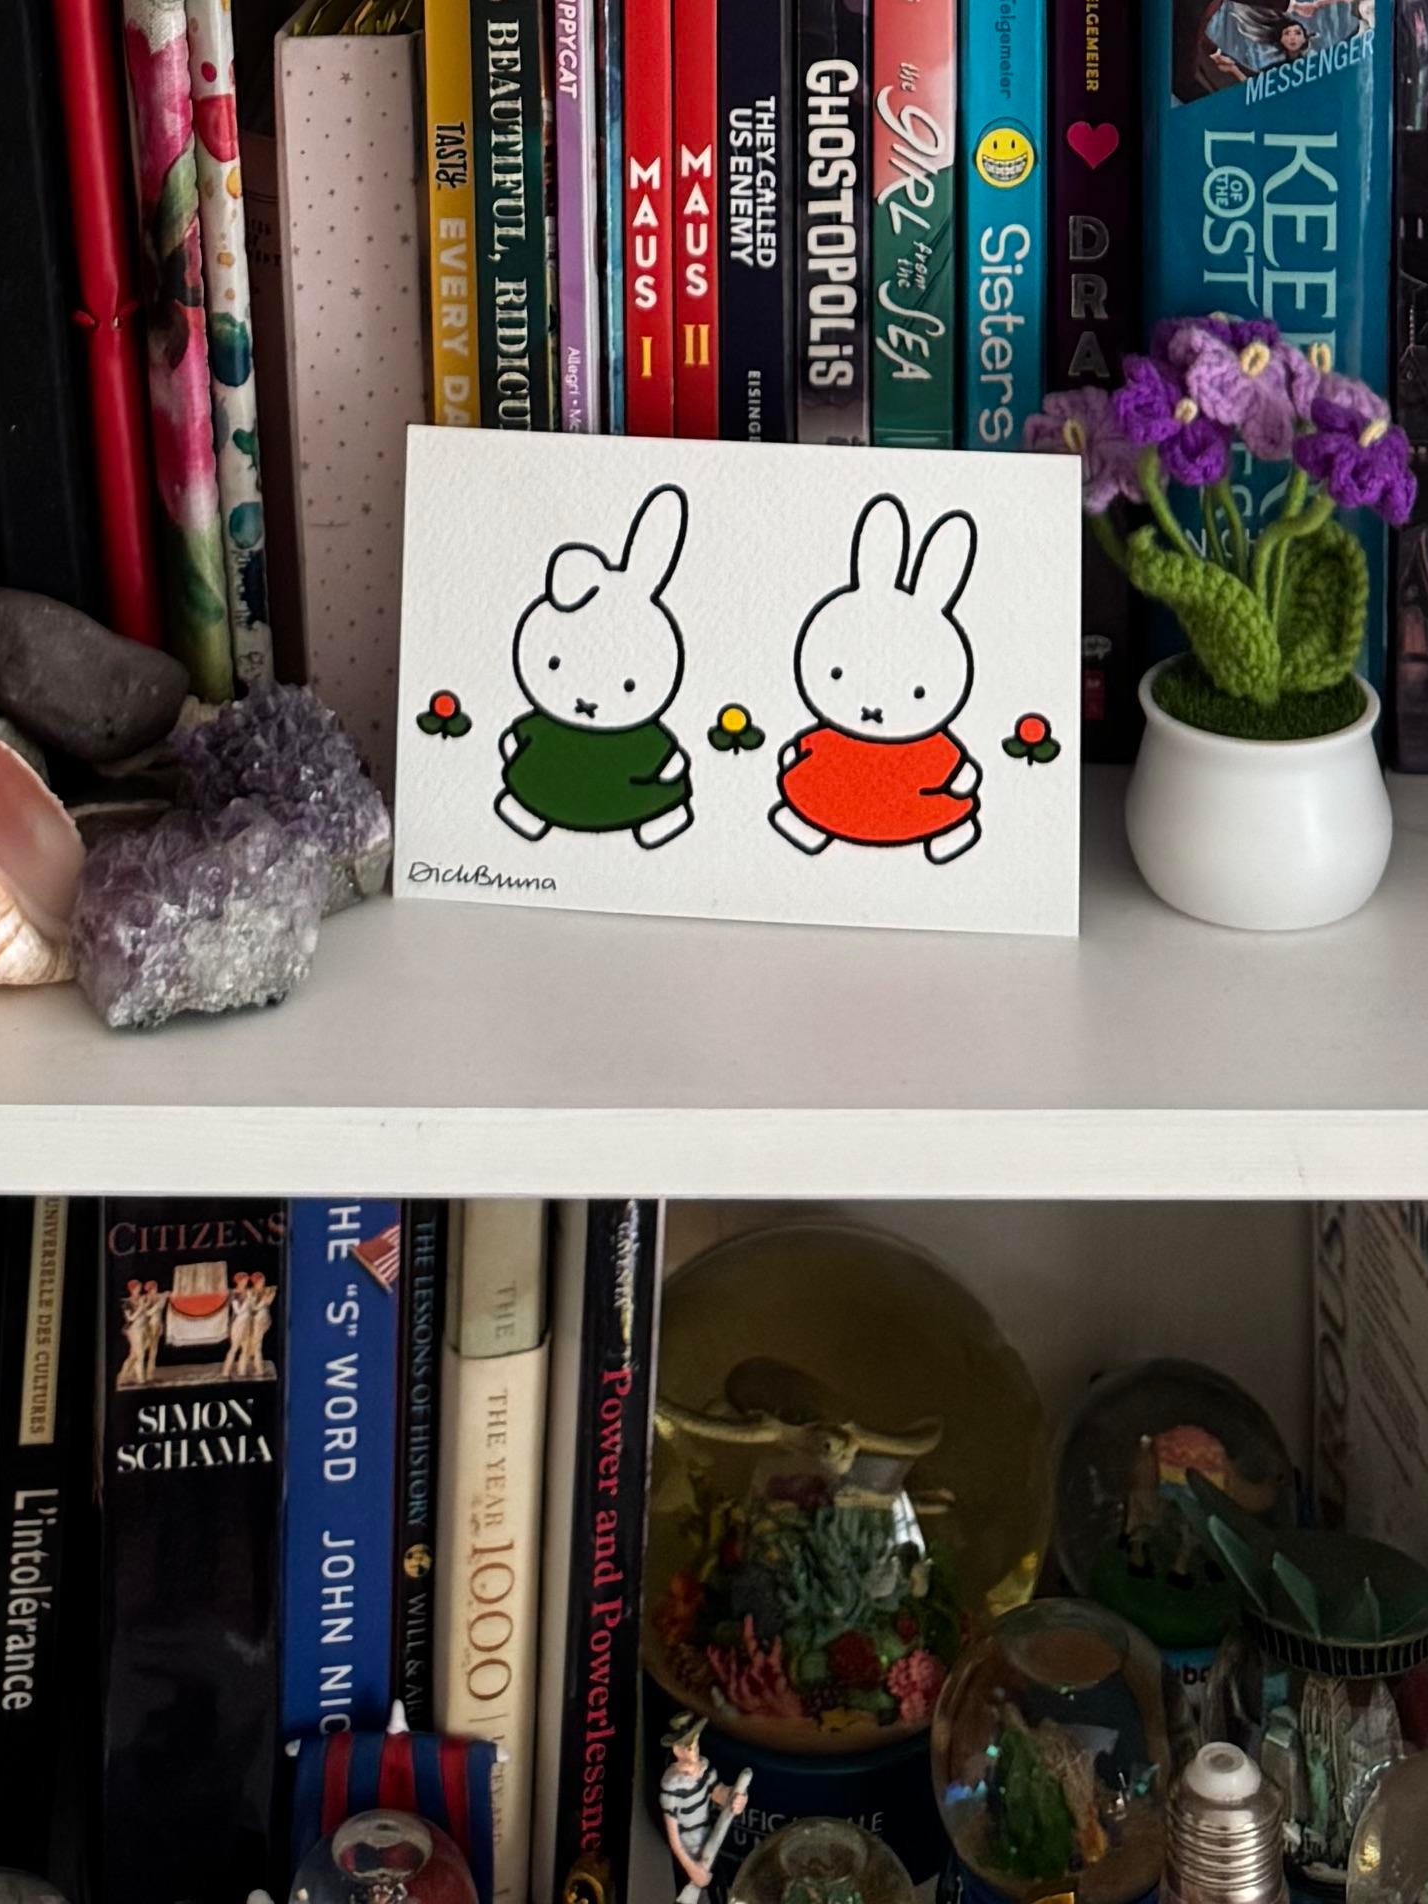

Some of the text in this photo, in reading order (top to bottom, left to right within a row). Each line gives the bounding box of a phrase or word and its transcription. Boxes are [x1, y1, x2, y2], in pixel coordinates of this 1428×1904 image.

[631, 156, 661, 379] MAUS I
[681, 144, 712, 367] MAUS II
[978, 223, 1031, 445] Sisters
[117, 1434, 273, 1472] SCHAMA
[137, 1398, 253, 1433] SIMON
[325, 1353, 358, 1484] WORD
[1, 1488, 58, 1712] L'intolérance
[321, 1533, 355, 1644] JOHN
